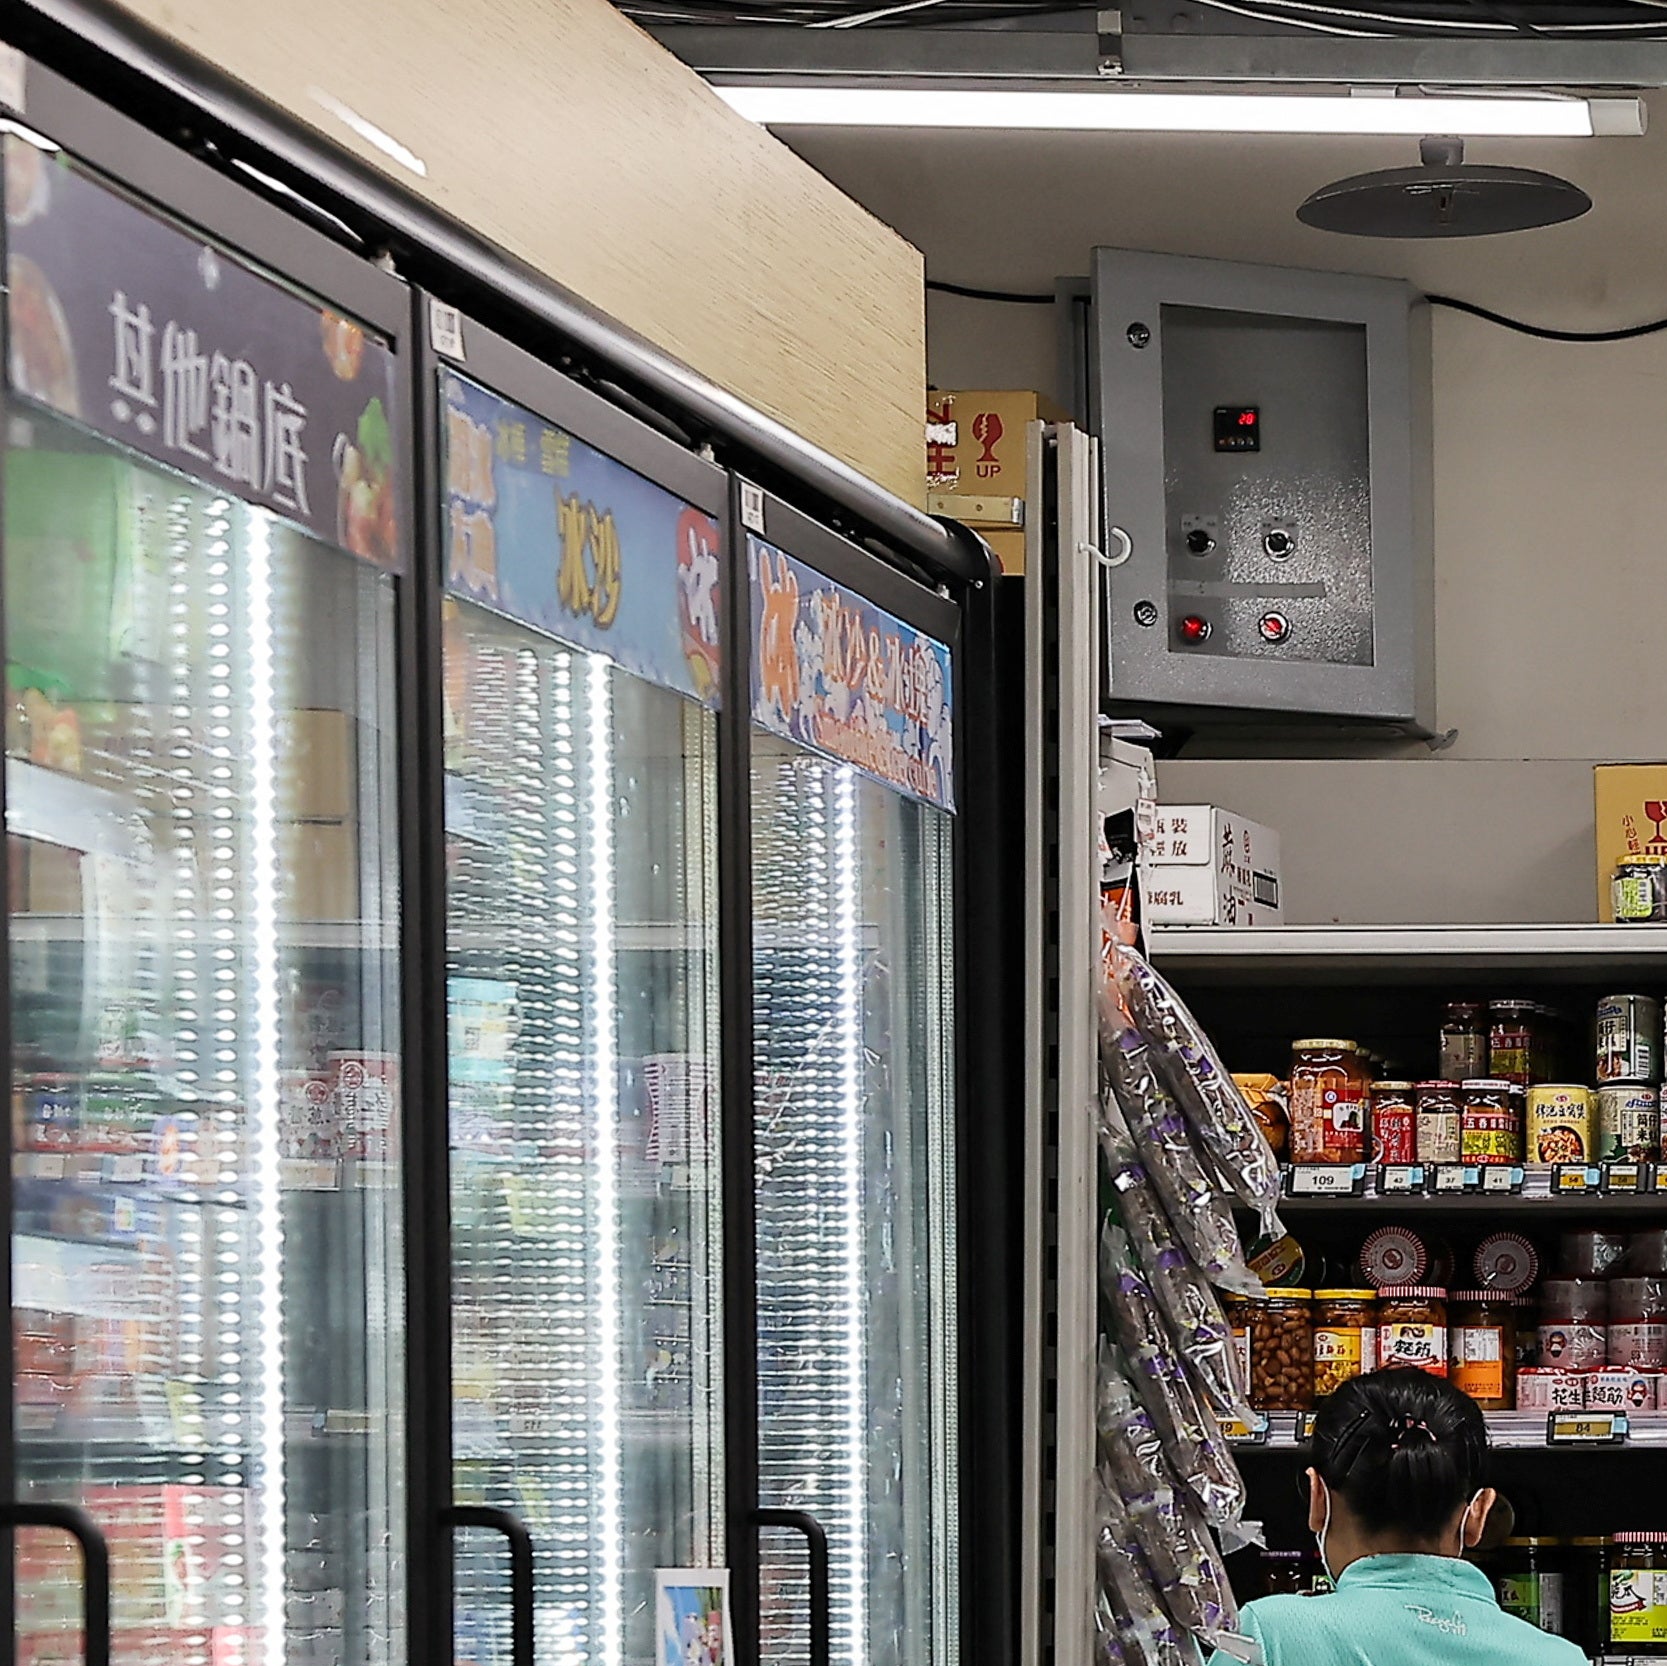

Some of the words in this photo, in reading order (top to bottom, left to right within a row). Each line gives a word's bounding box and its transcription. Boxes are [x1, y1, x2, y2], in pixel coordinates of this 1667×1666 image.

[108, 290, 311, 515] 其他鍋底
[976, 464, 1001, 478] UP
[1311, 1175, 1334, 1186] 109
